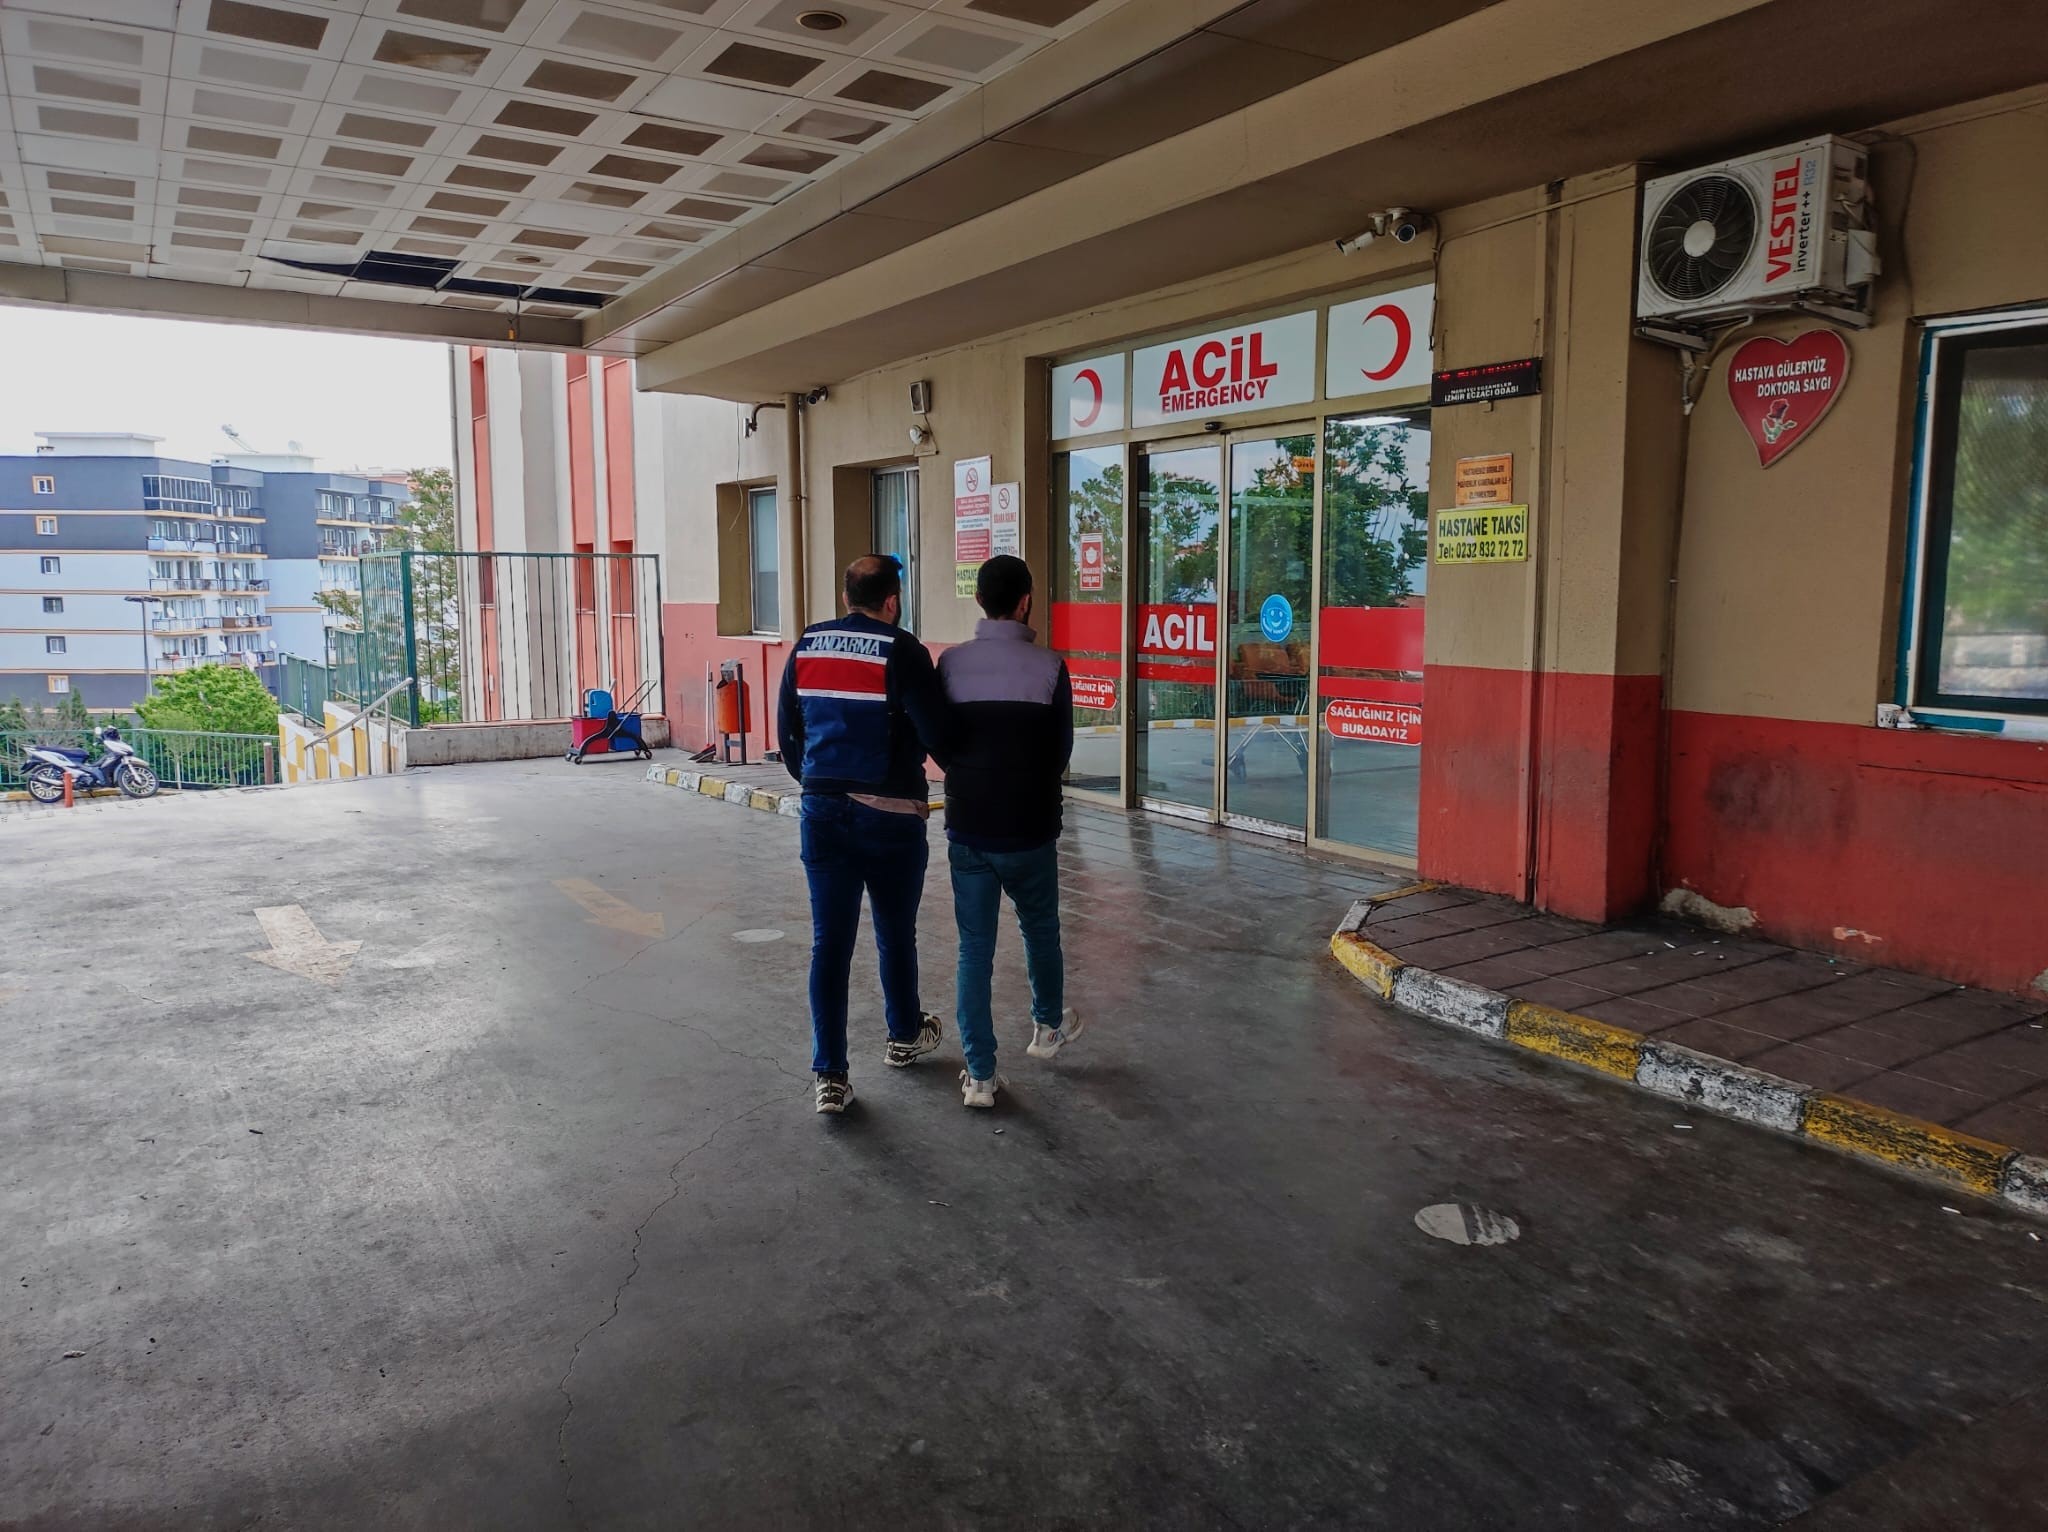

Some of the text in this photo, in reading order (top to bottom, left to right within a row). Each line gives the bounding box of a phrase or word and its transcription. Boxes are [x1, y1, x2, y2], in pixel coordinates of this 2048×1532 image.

[1765, 157, 1801, 283] VESTEL
[1735, 355, 1826, 382] HASTAYA GÜLERYÜZ
[1161, 379, 1269, 414] EMERGENCY
[1466, 389, 1493, 399] ECZACI
[1494, 385, 1519, 396] ODASI
[1757, 376, 1831, 397] DOKTORA SAYGI
[1439, 511, 1525, 537] HASTANE TAKSİ
[1439, 540, 1524, 559] Tel: 0232 832 72 72
[1143, 604, 1214, 651] ACİL
[807, 635, 880, 656] JANDARMA
[1330, 705, 1422, 727] SAĞLIĞINIZ İÇİN
[1342, 723, 1408, 740] BURADAYIZ
